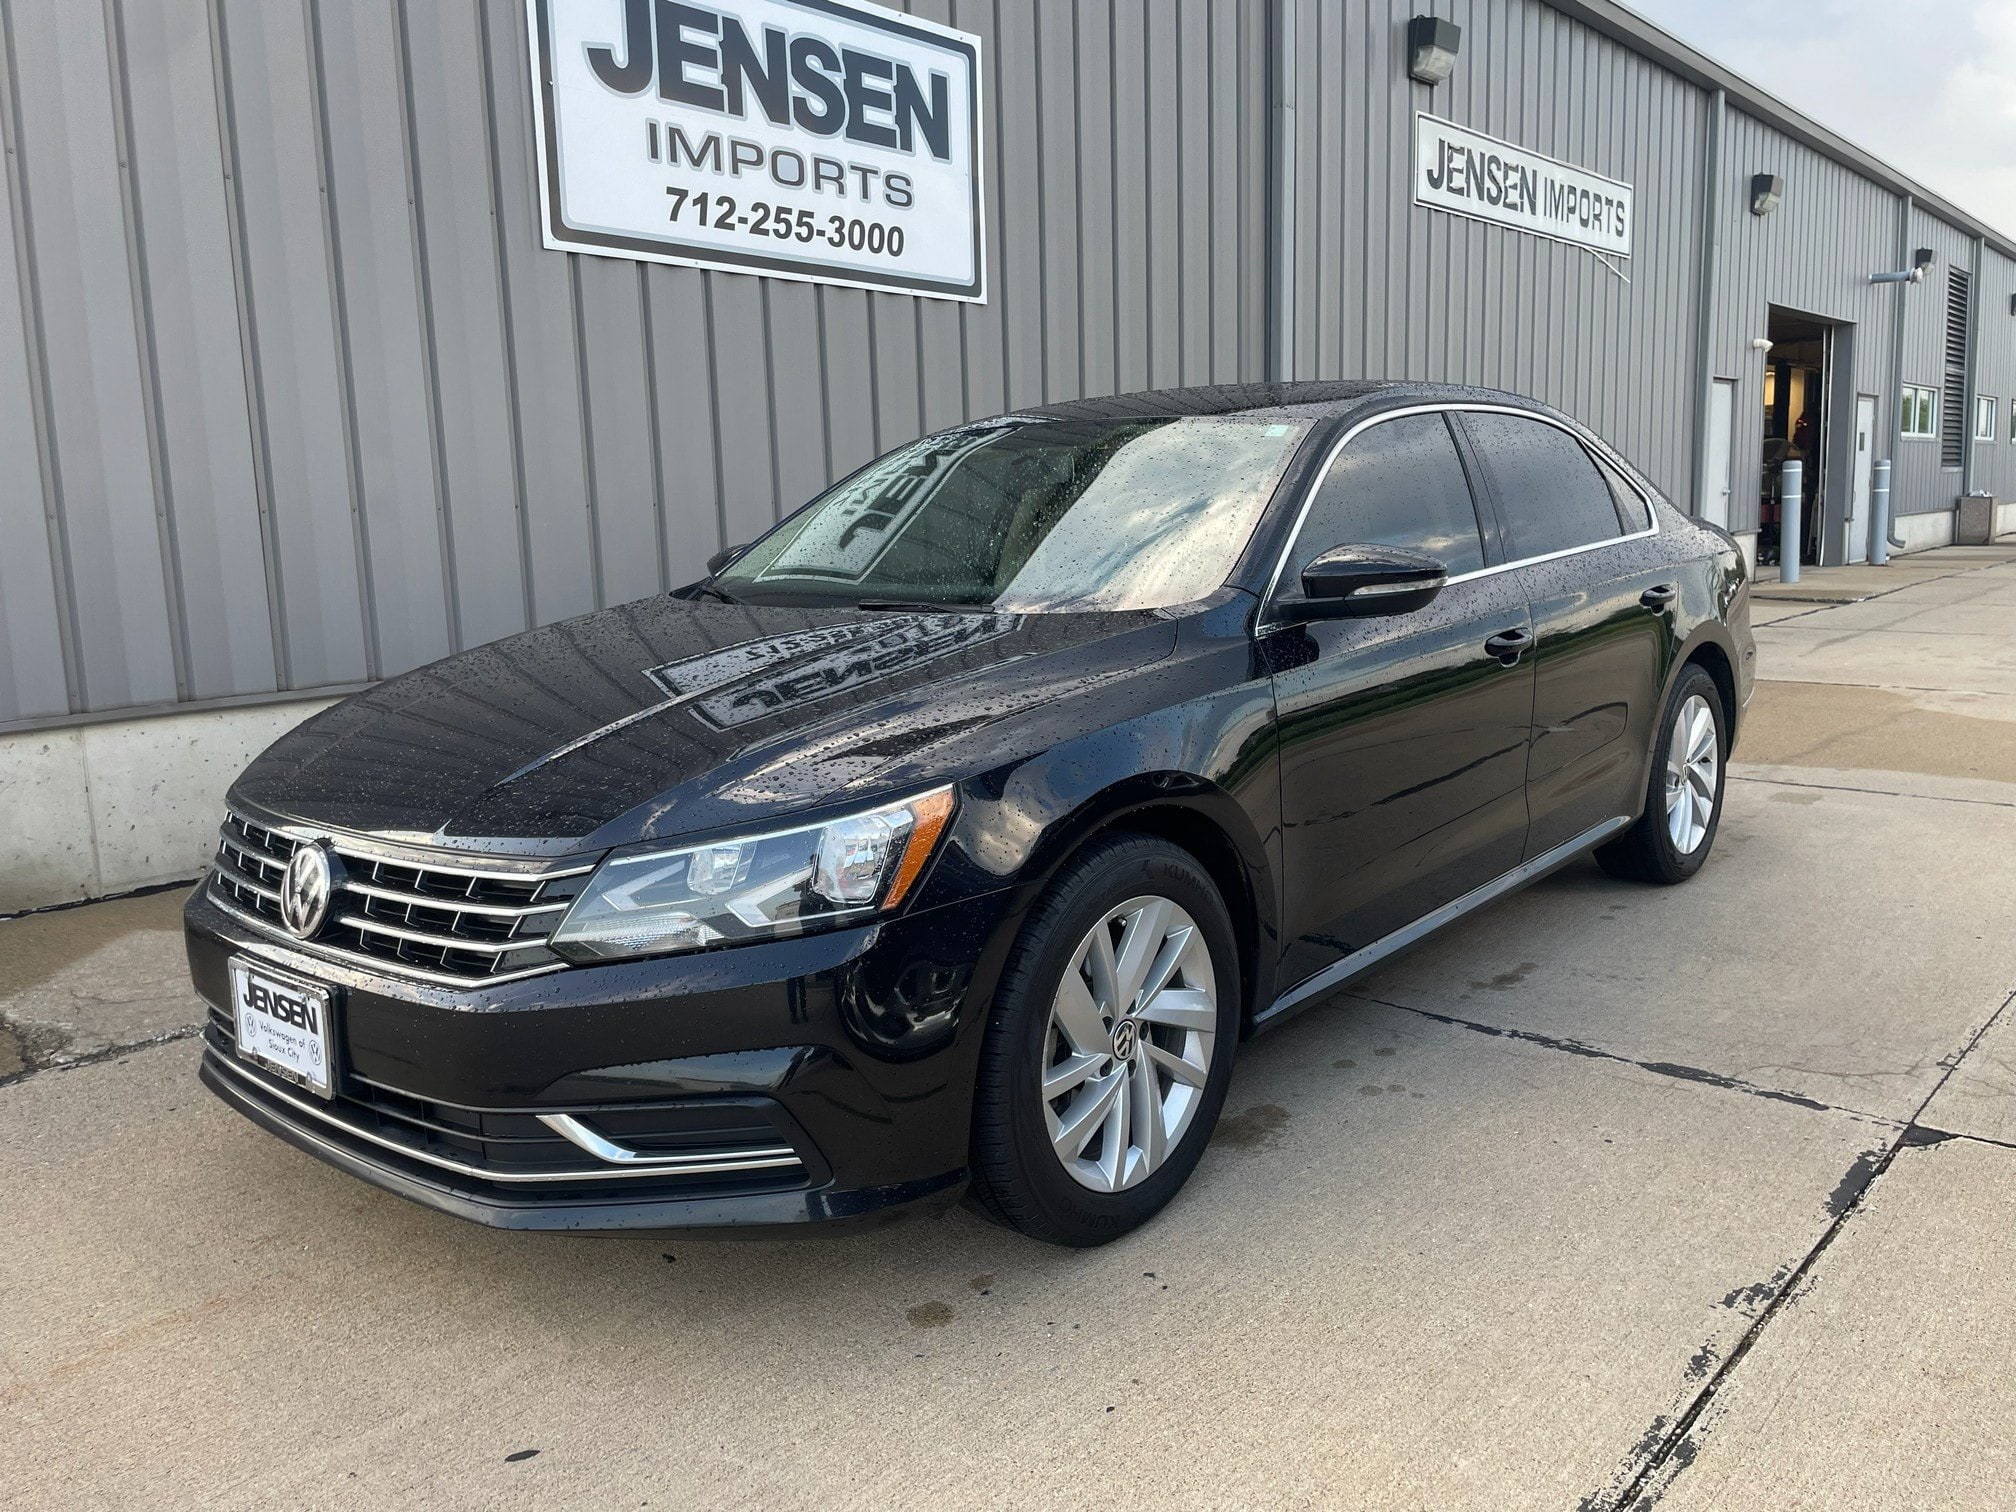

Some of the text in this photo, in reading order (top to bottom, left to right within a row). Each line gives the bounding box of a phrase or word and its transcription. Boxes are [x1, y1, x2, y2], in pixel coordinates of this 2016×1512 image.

[585, 0, 951, 162] JENSEN
[646, 119, 913, 209] IMPORTS
[1427, 138, 1625, 237] JENSEN IMPORTS
[665, 186, 904, 257] 712-255-3000
[243, 981, 318, 1035] JENSEN
[259, 1019, 306, 1049] Volkswagen of
[268, 1038, 300, 1063] Sioux City
